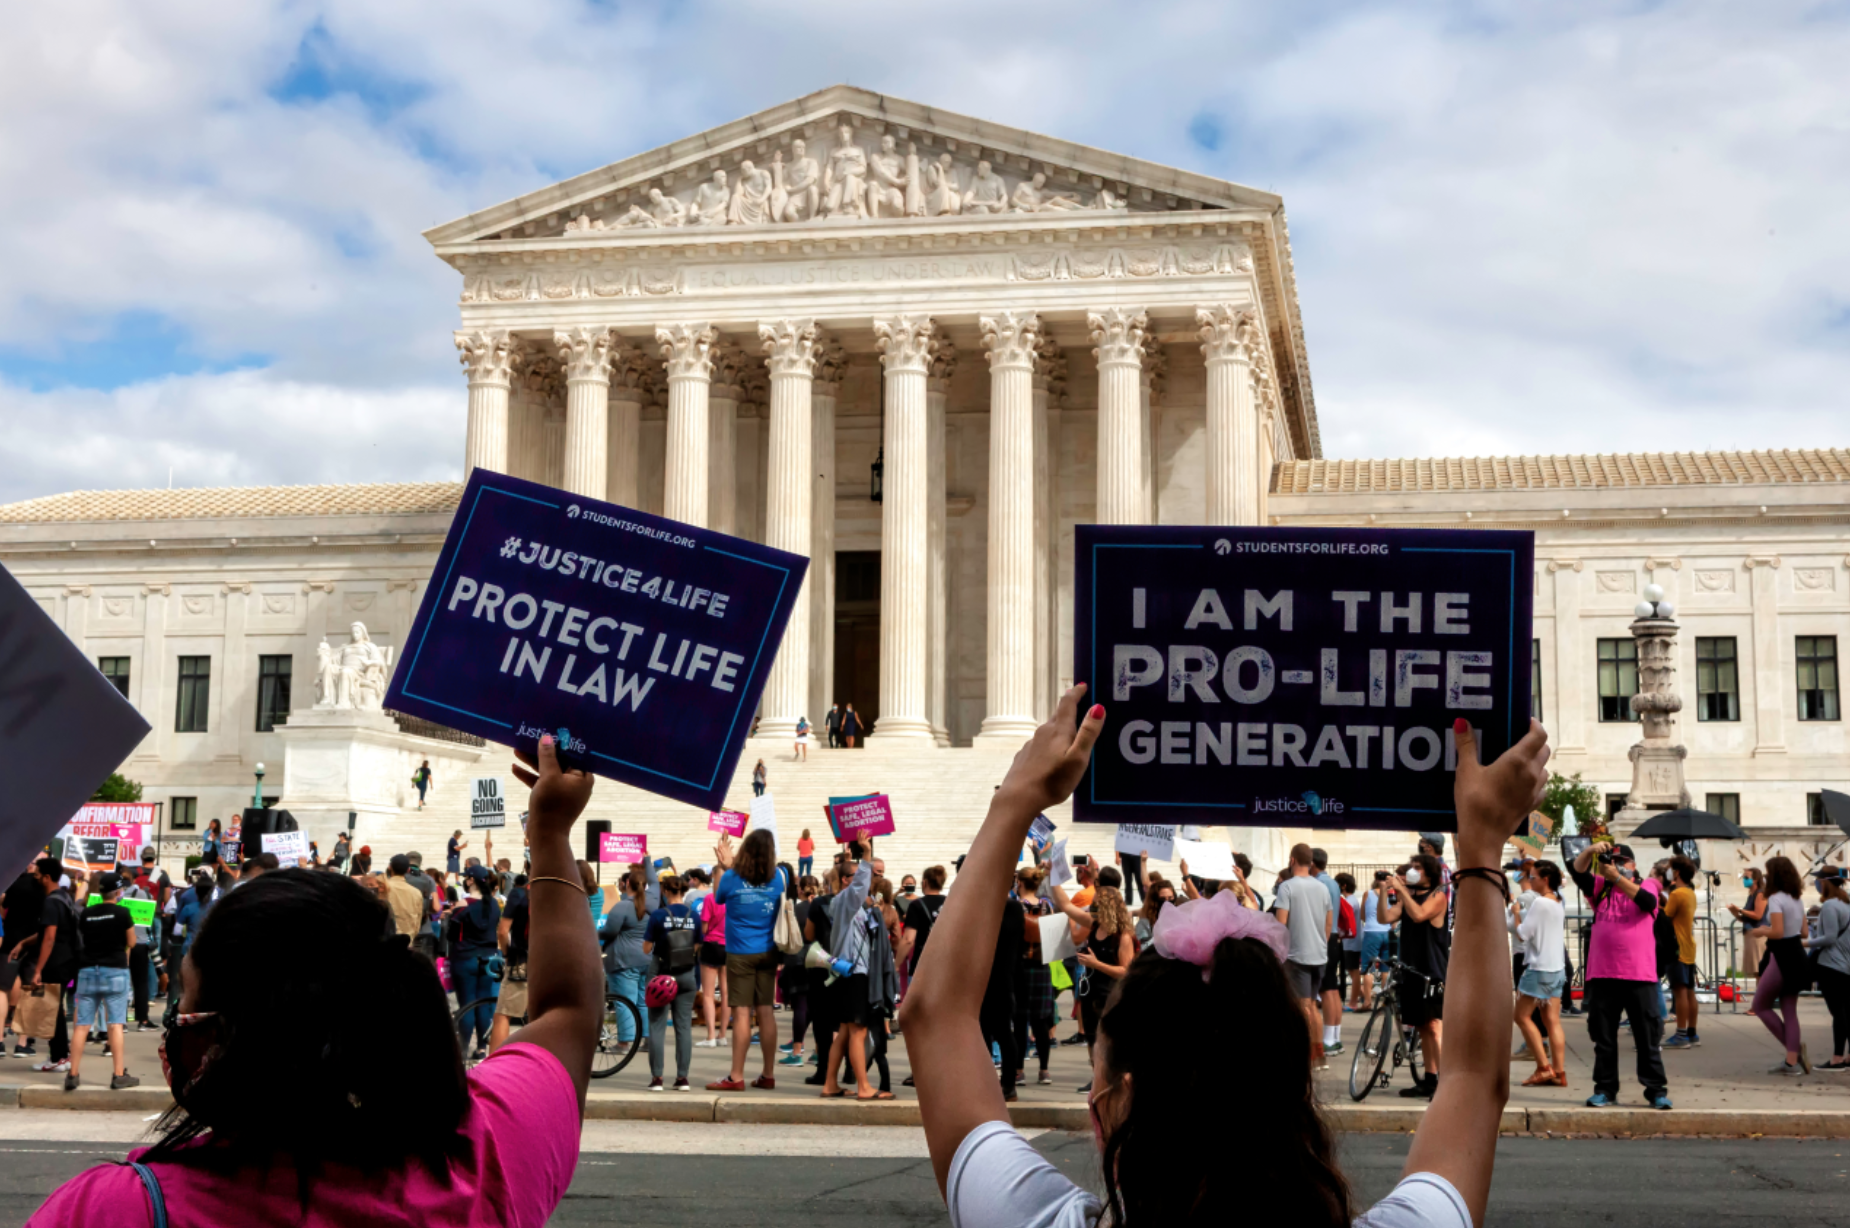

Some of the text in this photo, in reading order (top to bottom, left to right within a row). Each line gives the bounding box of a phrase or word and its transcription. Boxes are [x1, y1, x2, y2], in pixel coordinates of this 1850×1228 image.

[700, 260, 994, 288] EQUAL JUSTICE UNDER LAW
[582, 510, 696, 548] STUDENTSFORLIFE.ORG
[1236, 541, 1389, 555] STUDENTSFORLIFE.ORG
[500, 536, 730, 618] #JUSTICE4LIFE
[1132, 587, 1470, 635] I AM THE
[447, 576, 745, 693] PROTECT LIFE
[500, 637, 656, 712] IN LAW
[1113, 644, 1493, 709] PRO-LIFE
[478, 778, 497, 798] NO
[71, 806, 153, 823] ONFIRMATION
[472, 797, 504, 814] GOING
[843, 801, 878, 814] PROTECT
[861, 807, 887, 818] LEGAL
[844, 814, 885, 828] ABORTION
